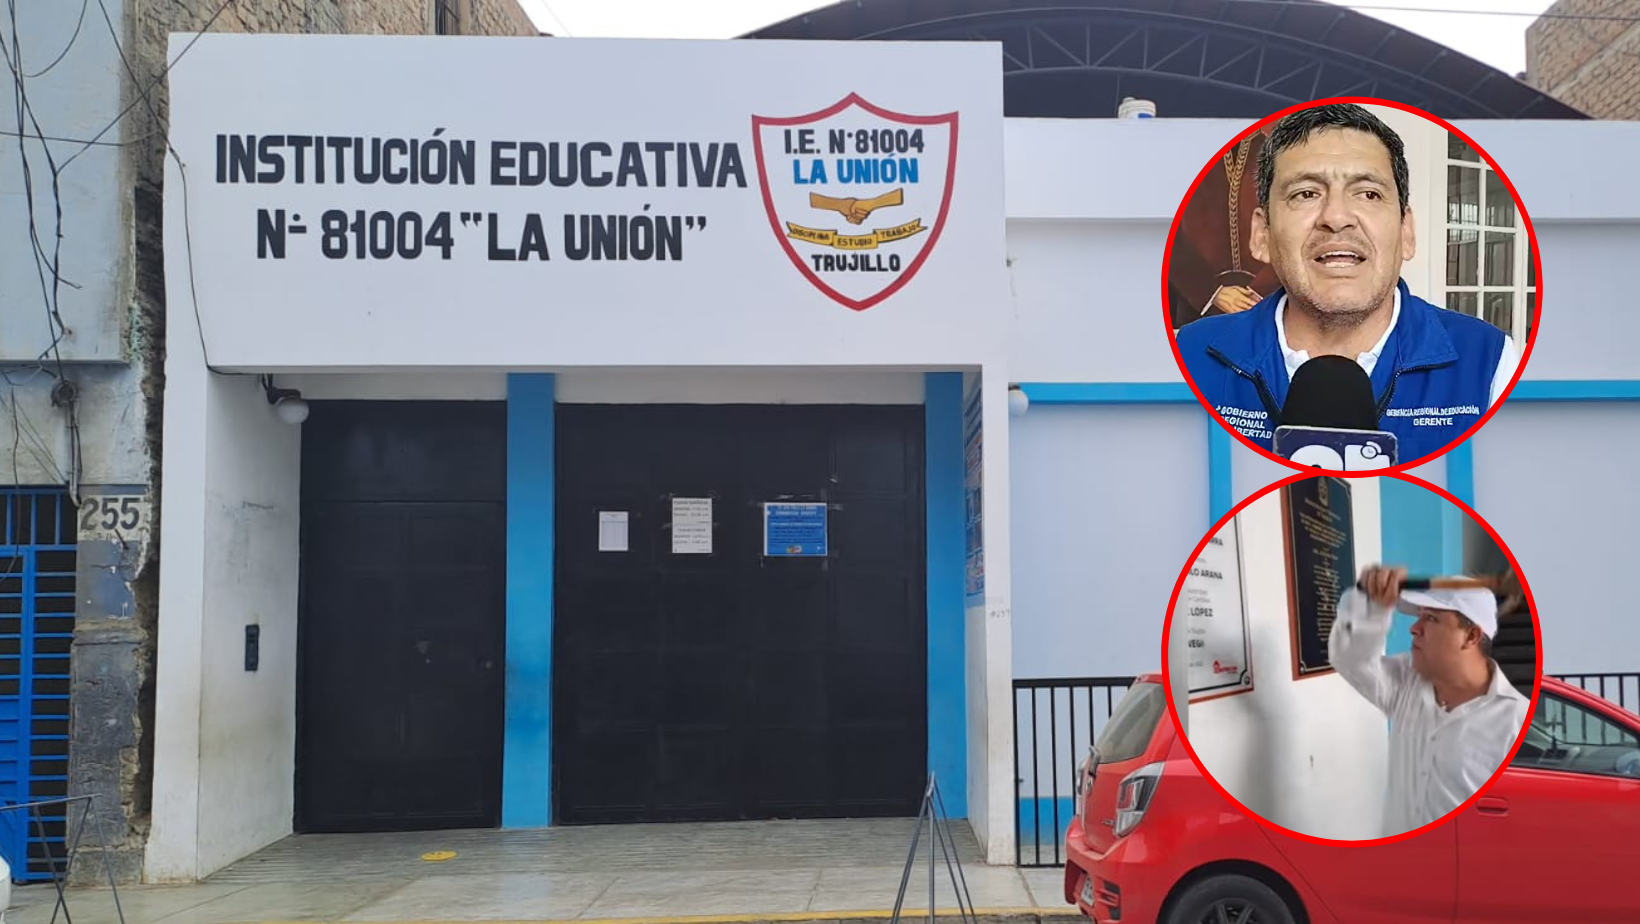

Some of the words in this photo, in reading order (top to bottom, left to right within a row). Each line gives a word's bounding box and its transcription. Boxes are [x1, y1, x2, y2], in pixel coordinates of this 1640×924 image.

[783, 128, 821, 155] I.E.
[215, 127, 476, 186] INSTITUCIÓN
[490, 140, 748, 188] EDUCATIVA
[792, 158, 828, 185] LA
[836, 152, 919, 184] UNIÓN
[837, 238, 873, 247] ESTUDIO
[881, 224, 917, 239] TRABAJO
[810, 253, 902, 272] TRUJILLO
[1220, 406, 1268, 420] GOBIERNO
[1413, 417, 1454, 426] GERENTE
[80, 497, 141, 531] 255
[1201, 569, 1223, 580] ARANA
